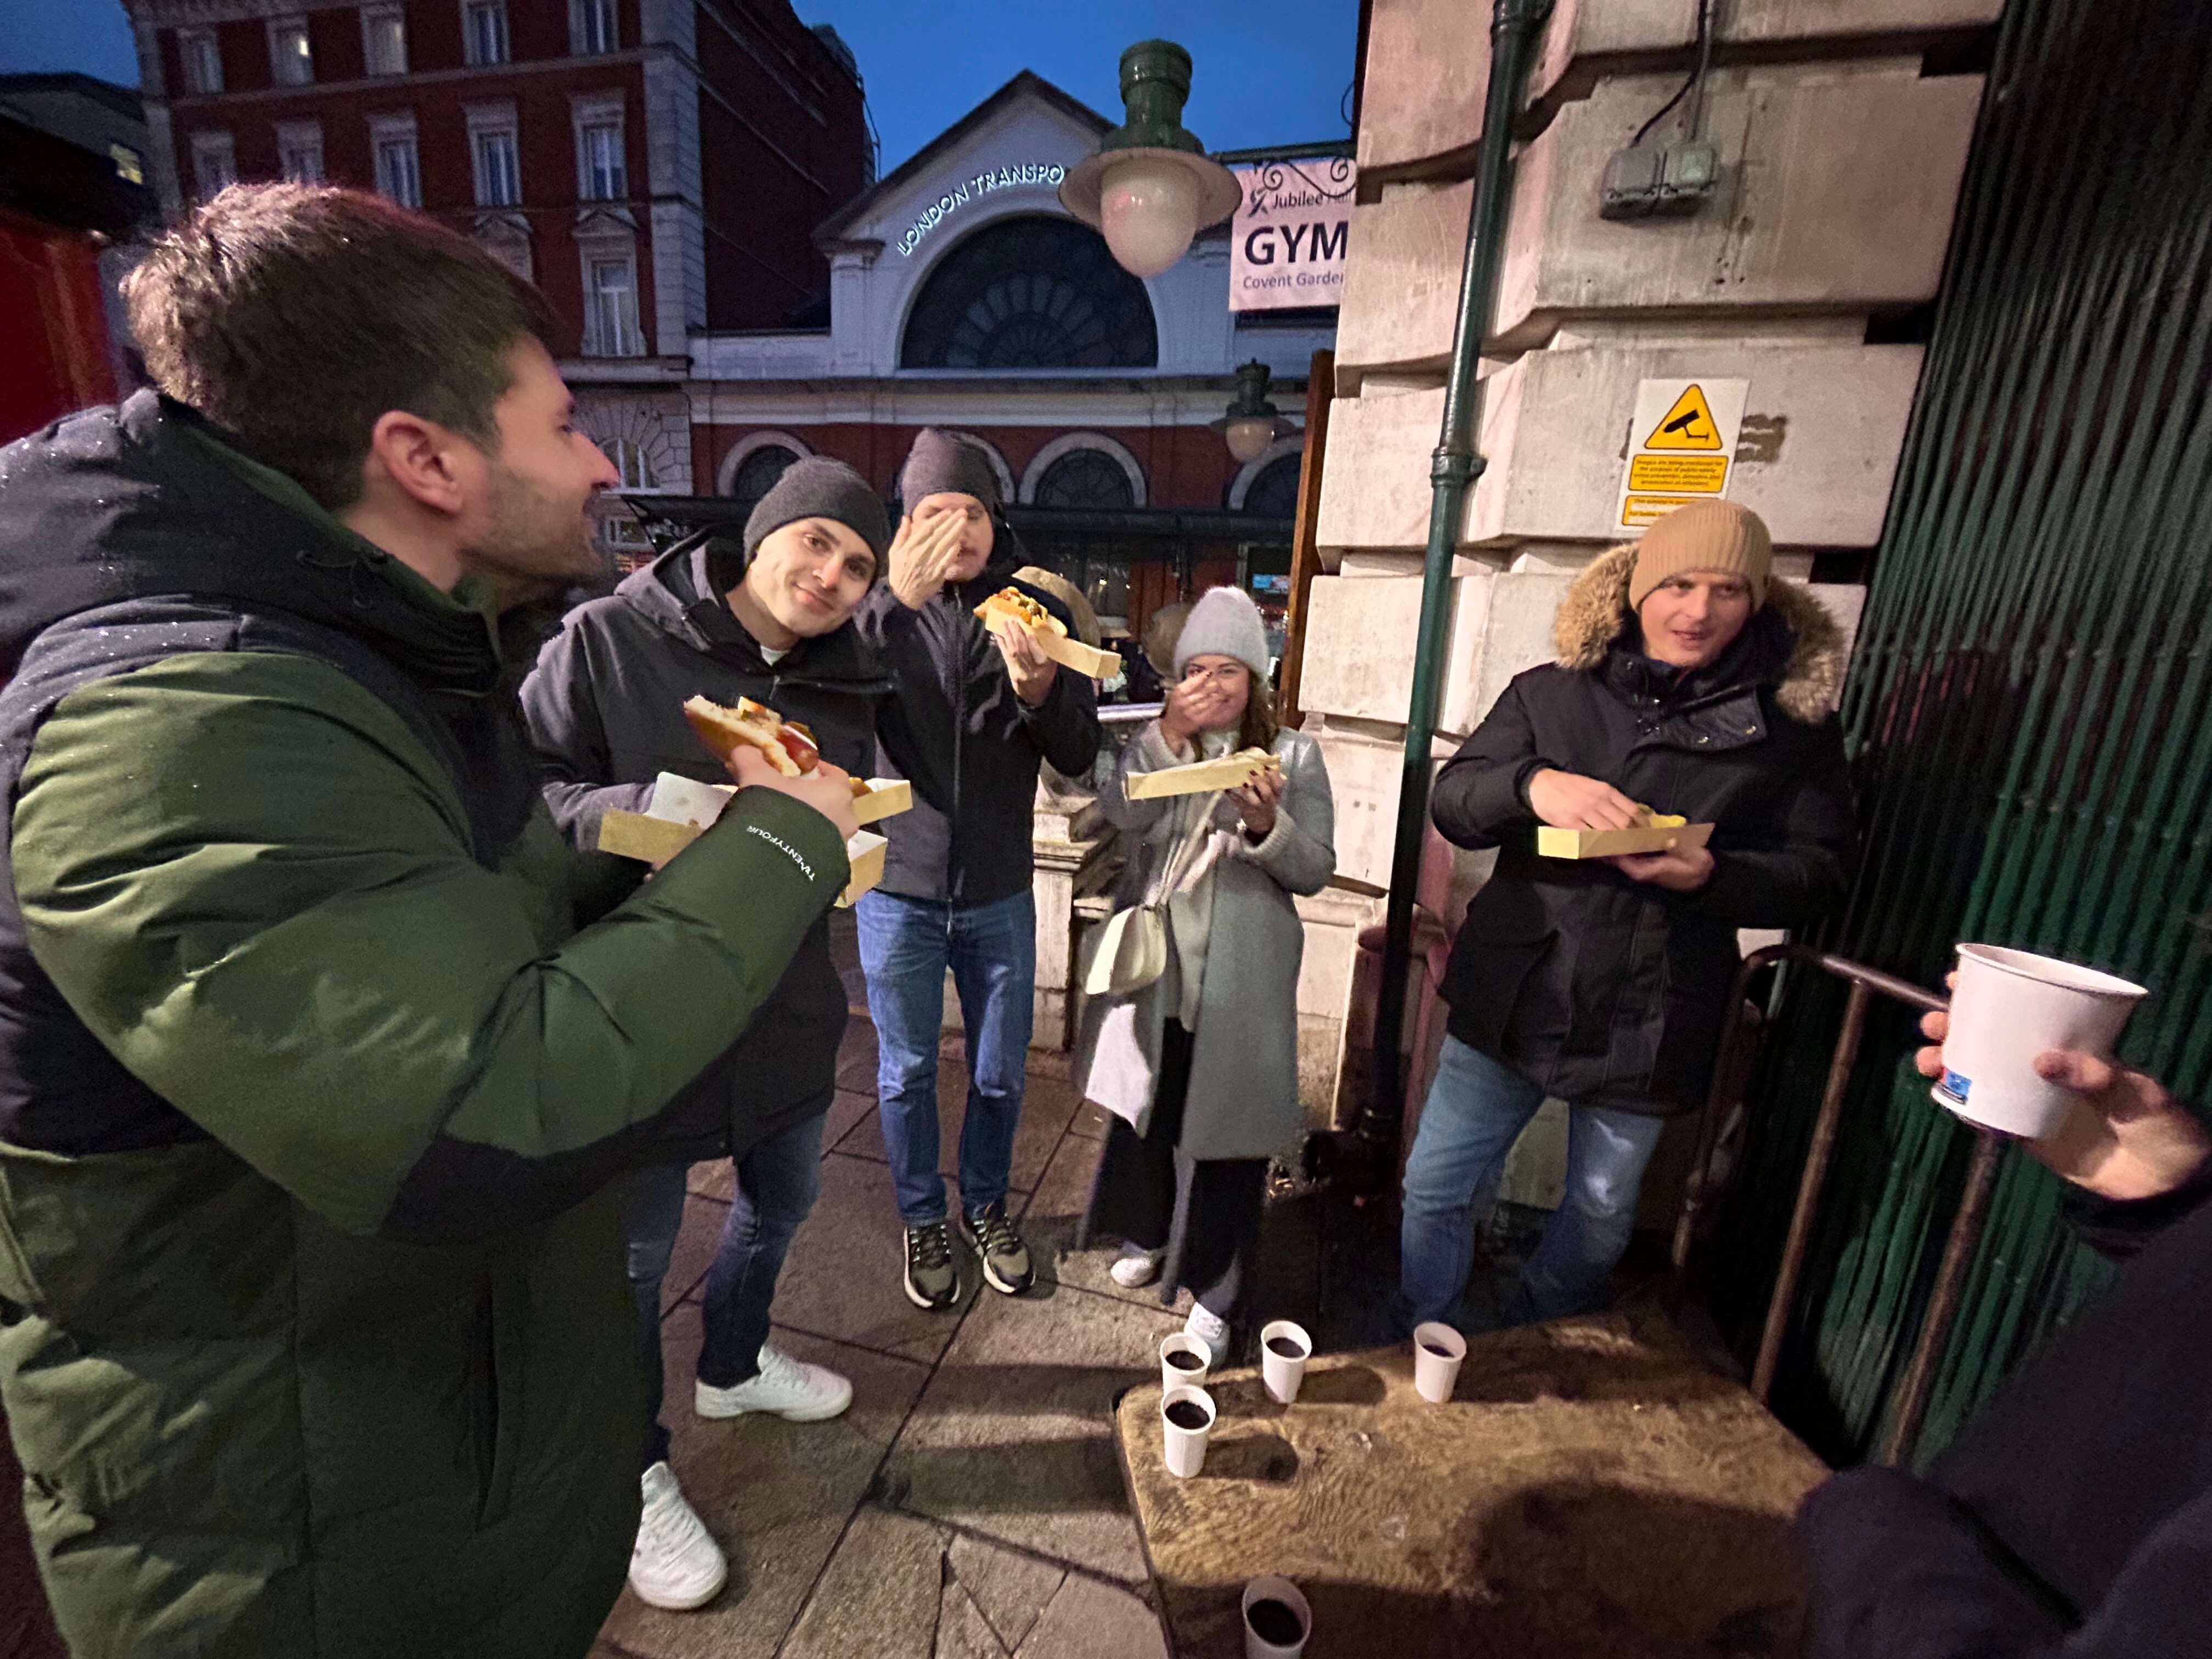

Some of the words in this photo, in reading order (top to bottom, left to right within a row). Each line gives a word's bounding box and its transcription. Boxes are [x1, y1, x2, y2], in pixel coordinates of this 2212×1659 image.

[898, 182, 969, 256] LONDON
[971, 163, 1066, 195] TRANSPO
[1272, 190, 1323, 209] Jubilee
[1244, 221, 1349, 266] GYM
[1243, 273, 1292, 289] Covent
[746, 825, 815, 881] TWENTYFOUR
